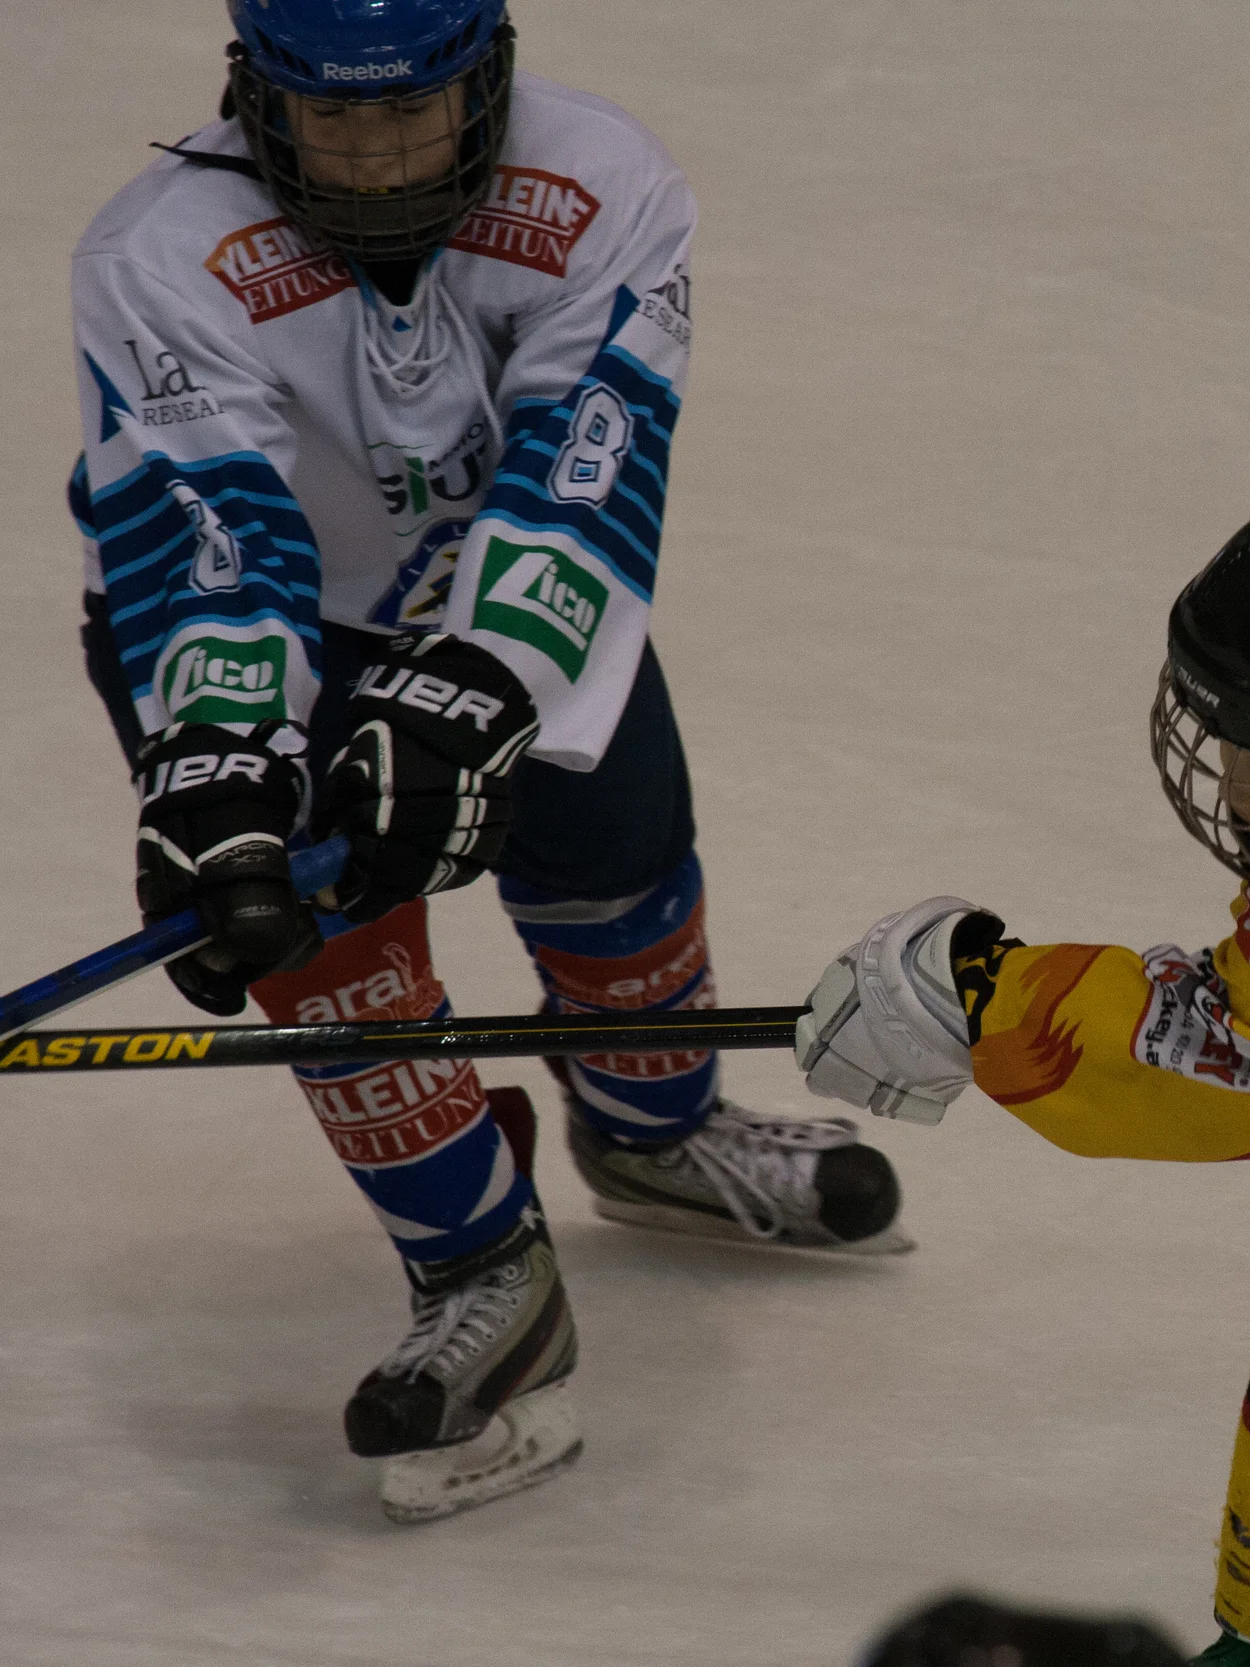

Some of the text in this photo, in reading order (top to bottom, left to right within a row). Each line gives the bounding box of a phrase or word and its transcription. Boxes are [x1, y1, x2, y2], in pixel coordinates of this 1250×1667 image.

[323, 59, 413, 81] Reebok
[546, 381, 634, 510] 8
[296, 968, 406, 1022] ara
[0, 1031, 217, 1068] ASTON
